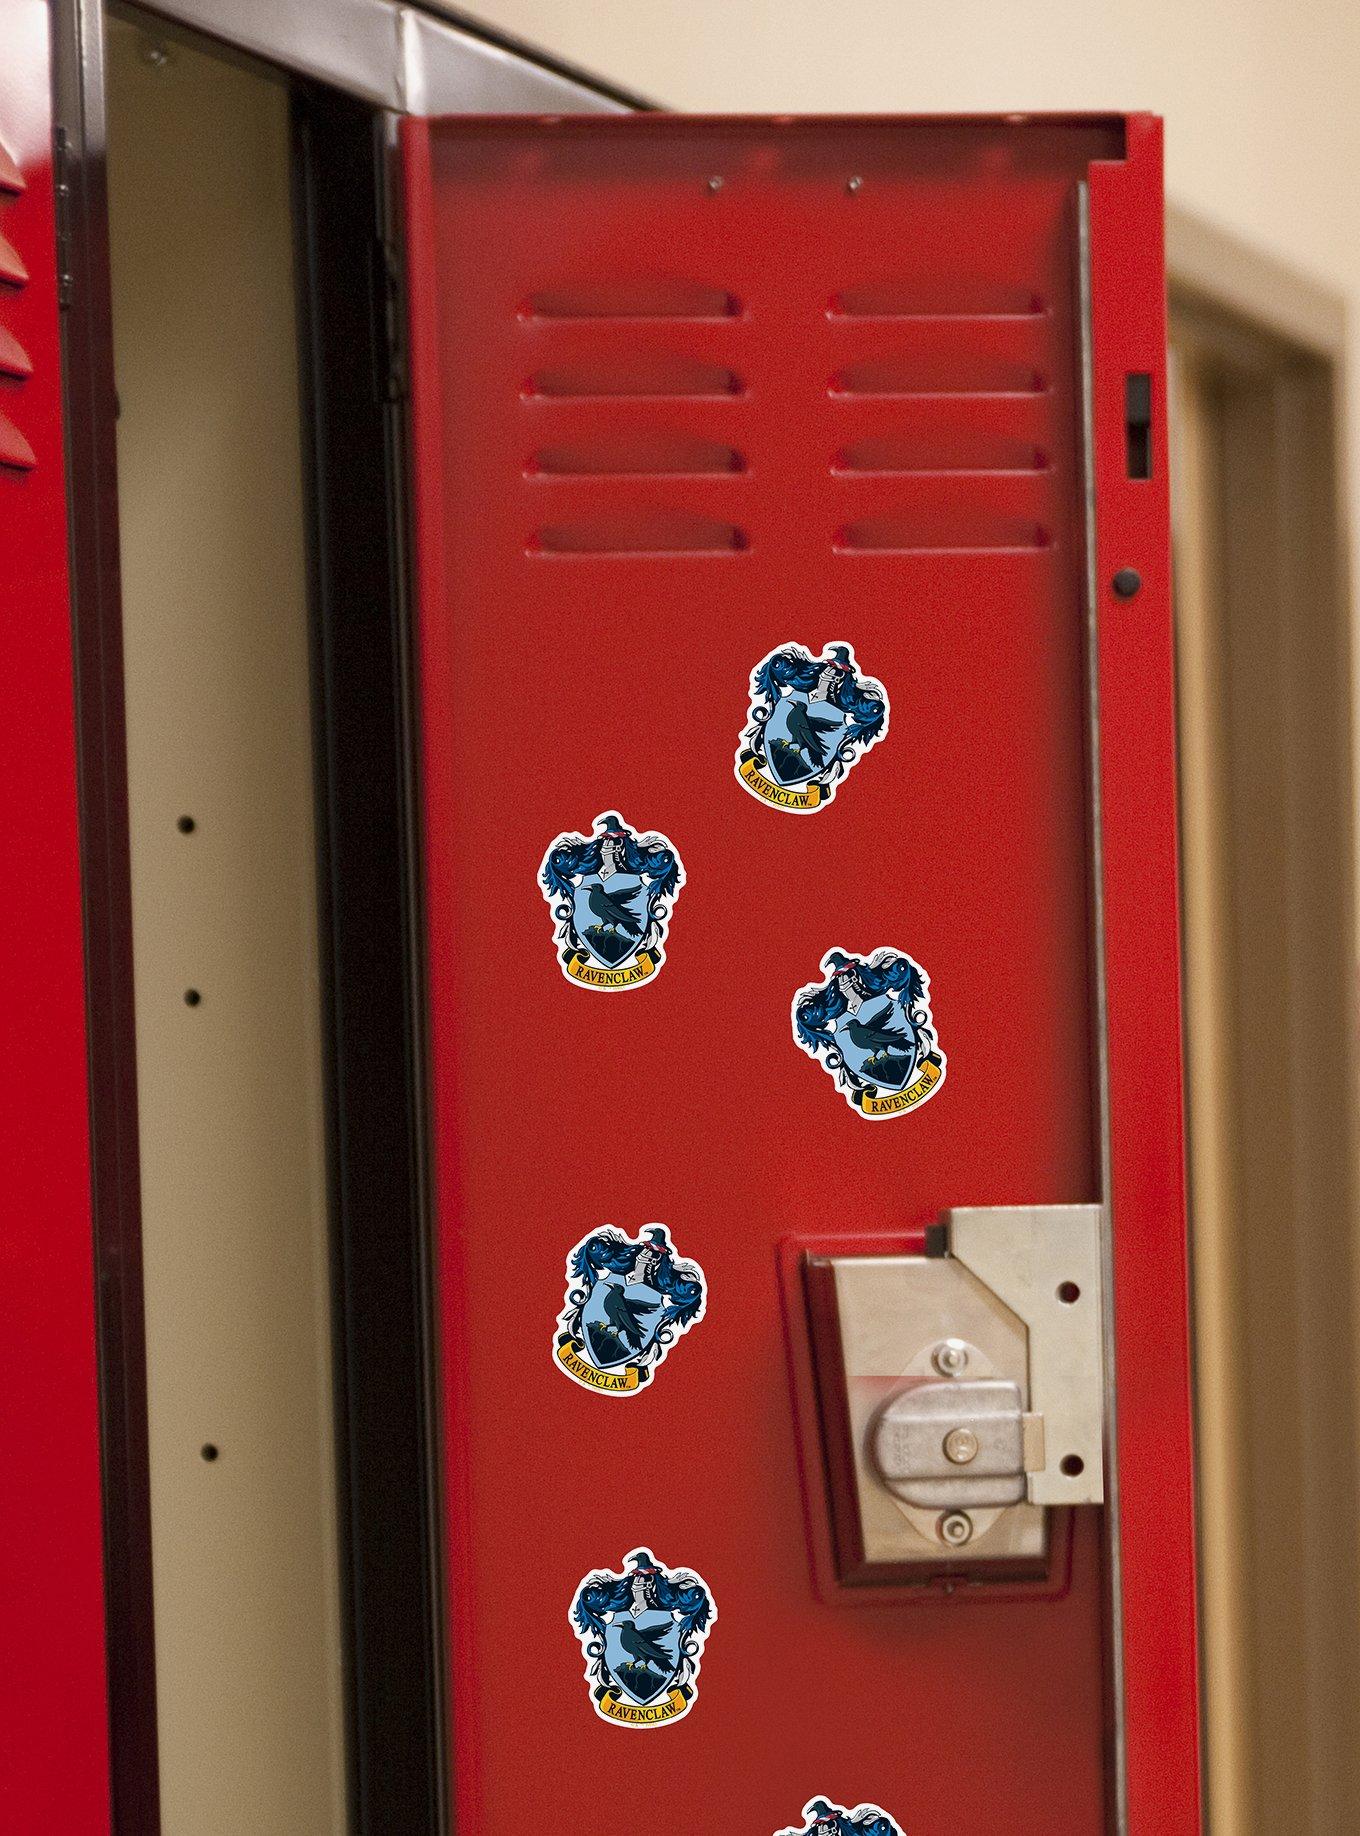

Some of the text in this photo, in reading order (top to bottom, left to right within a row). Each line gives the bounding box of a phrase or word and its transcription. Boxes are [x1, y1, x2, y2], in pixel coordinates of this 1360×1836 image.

[745, 769, 810, 806] RAVENCLAW
[575, 965, 645, 984] RAVENCLAW
[872, 1074, 935, 1112] RAVENCLAW
[563, 1353, 629, 1388] RAVENCLAW
[607, 1702, 678, 1720] RAVENCLAW
